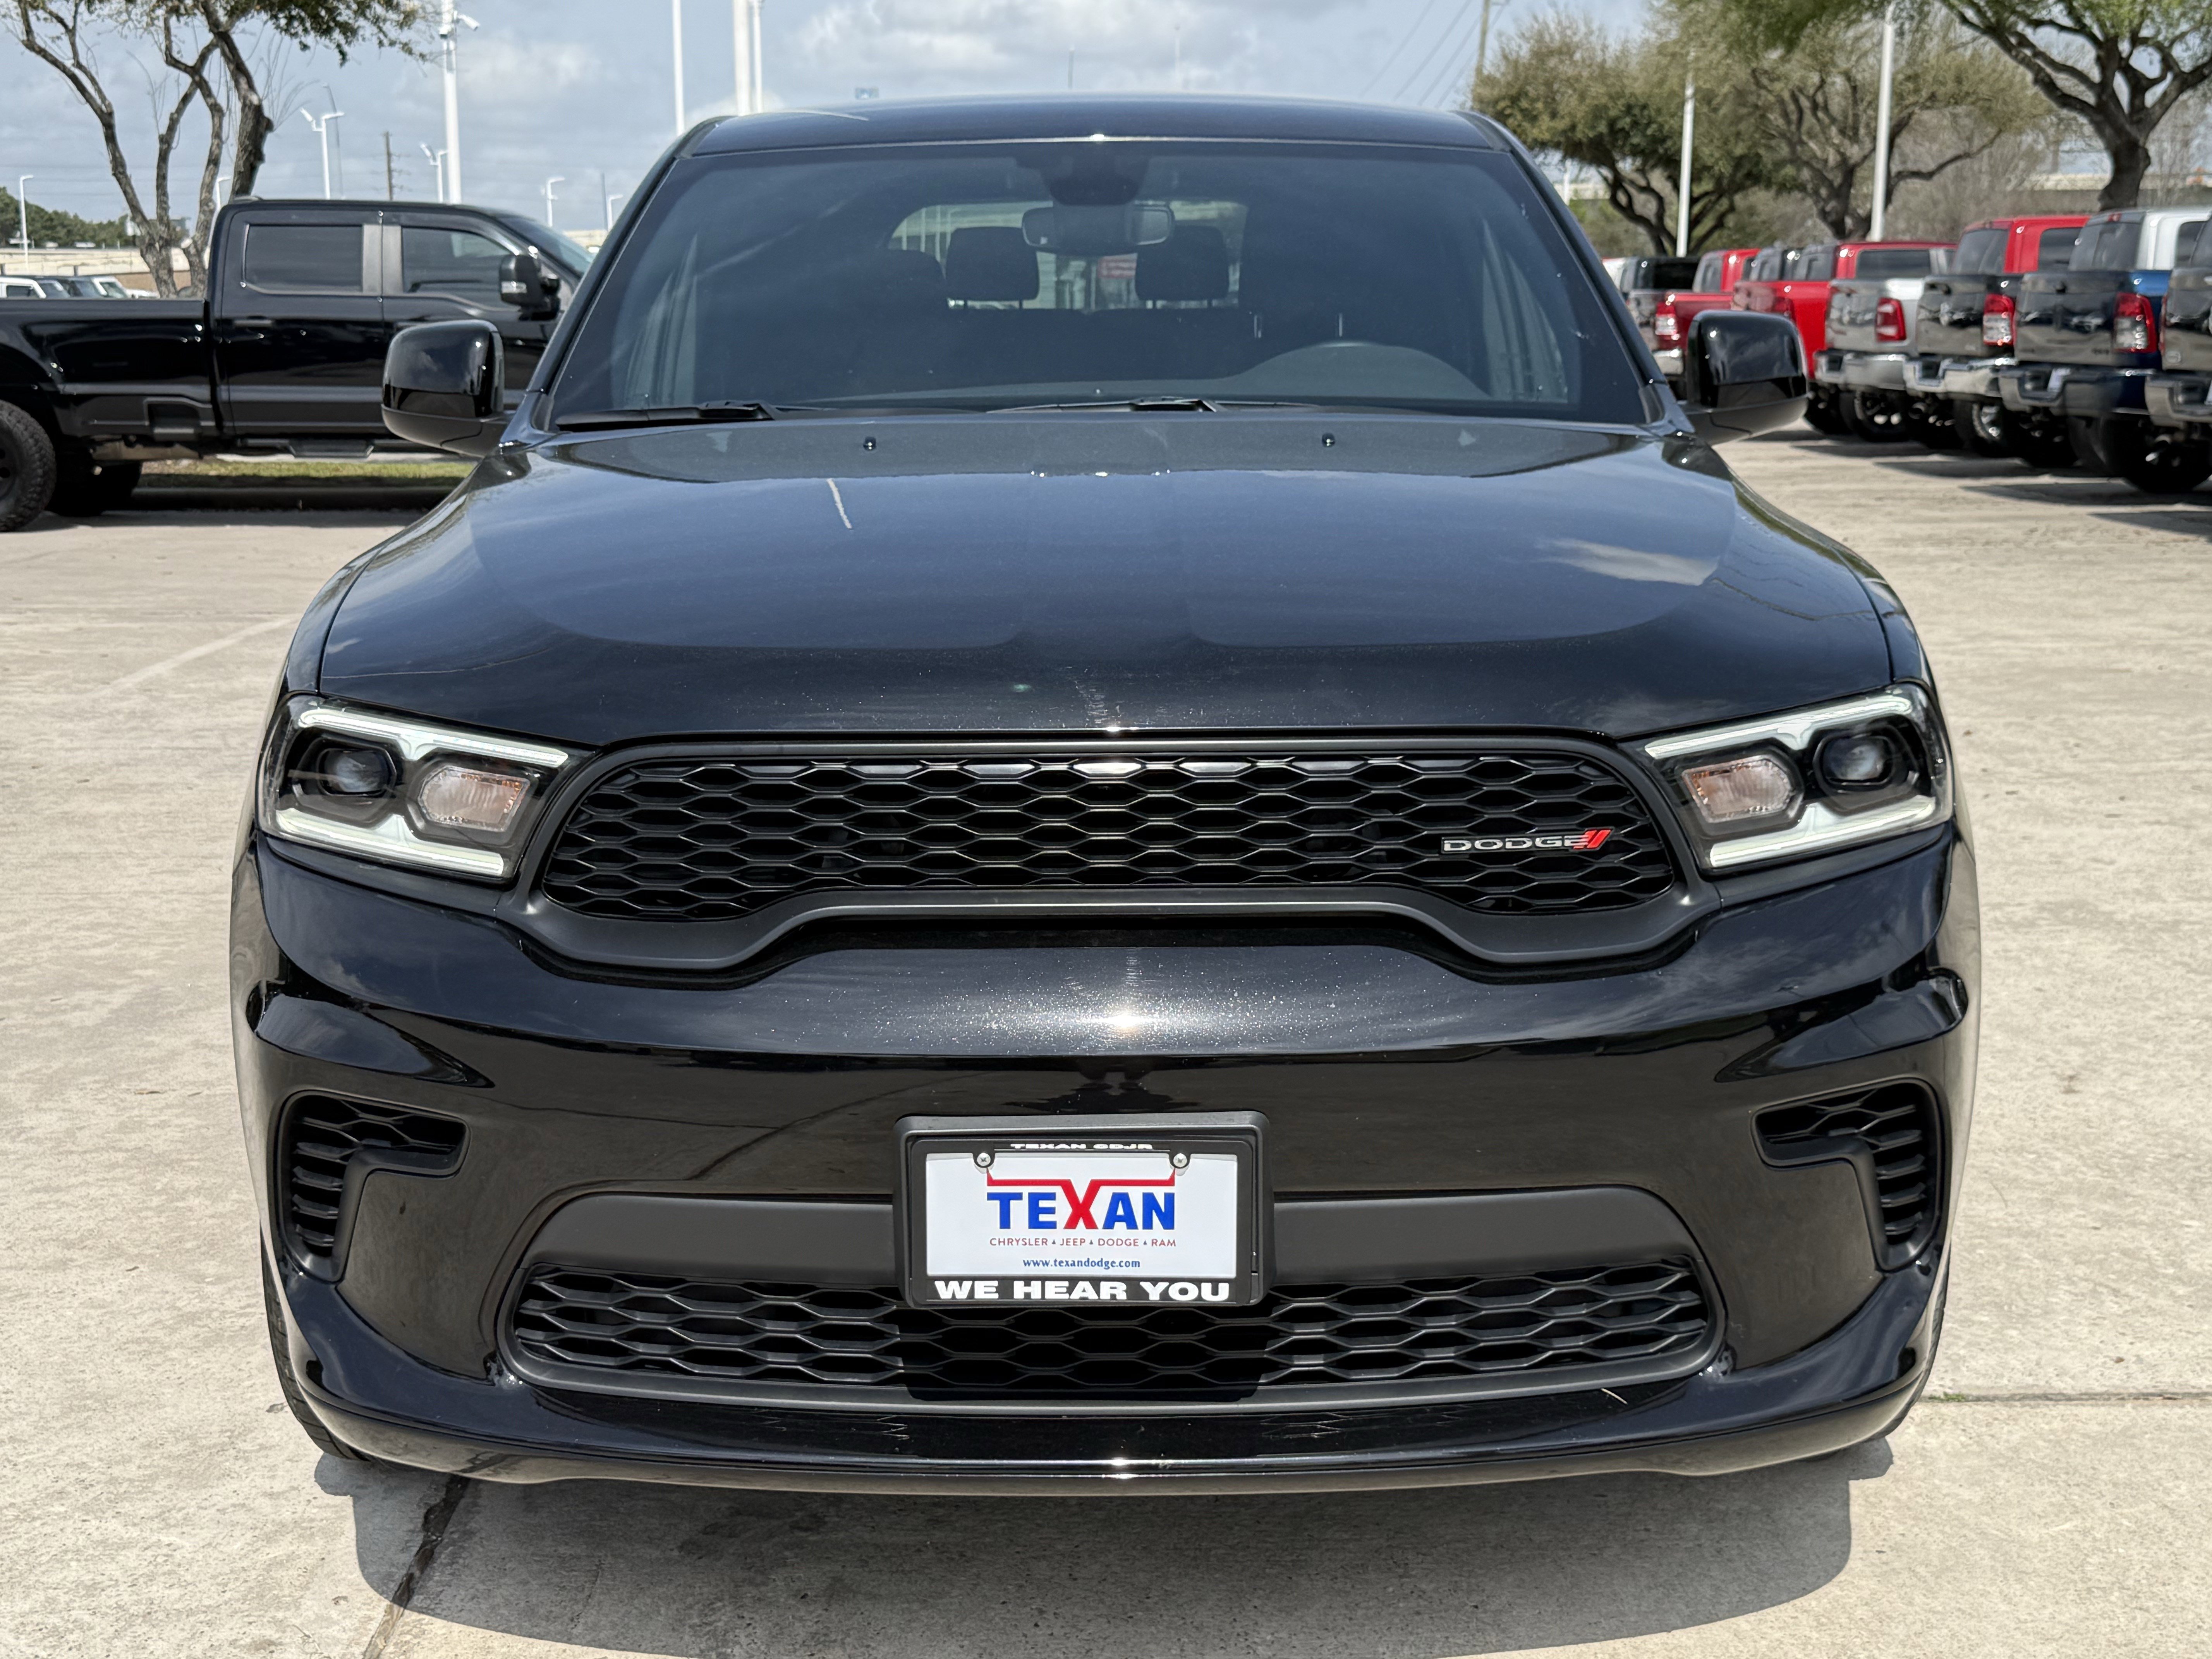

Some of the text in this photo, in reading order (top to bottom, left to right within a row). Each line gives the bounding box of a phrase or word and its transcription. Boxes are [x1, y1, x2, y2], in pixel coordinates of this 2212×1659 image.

[1444, 835, 1589, 851] DODGE
[987, 1179, 1175, 1230] TEXAN
[989, 1238, 1048, 1246] CHRYSLER
[1060, 1238, 1085, 1246] JEEP
[1098, 1238, 1139, 1247] DODGE
[1023, 1257, 1140, 1270] www.texandodge.com
[934, 1281, 1230, 1302] WE HEAR YOU
